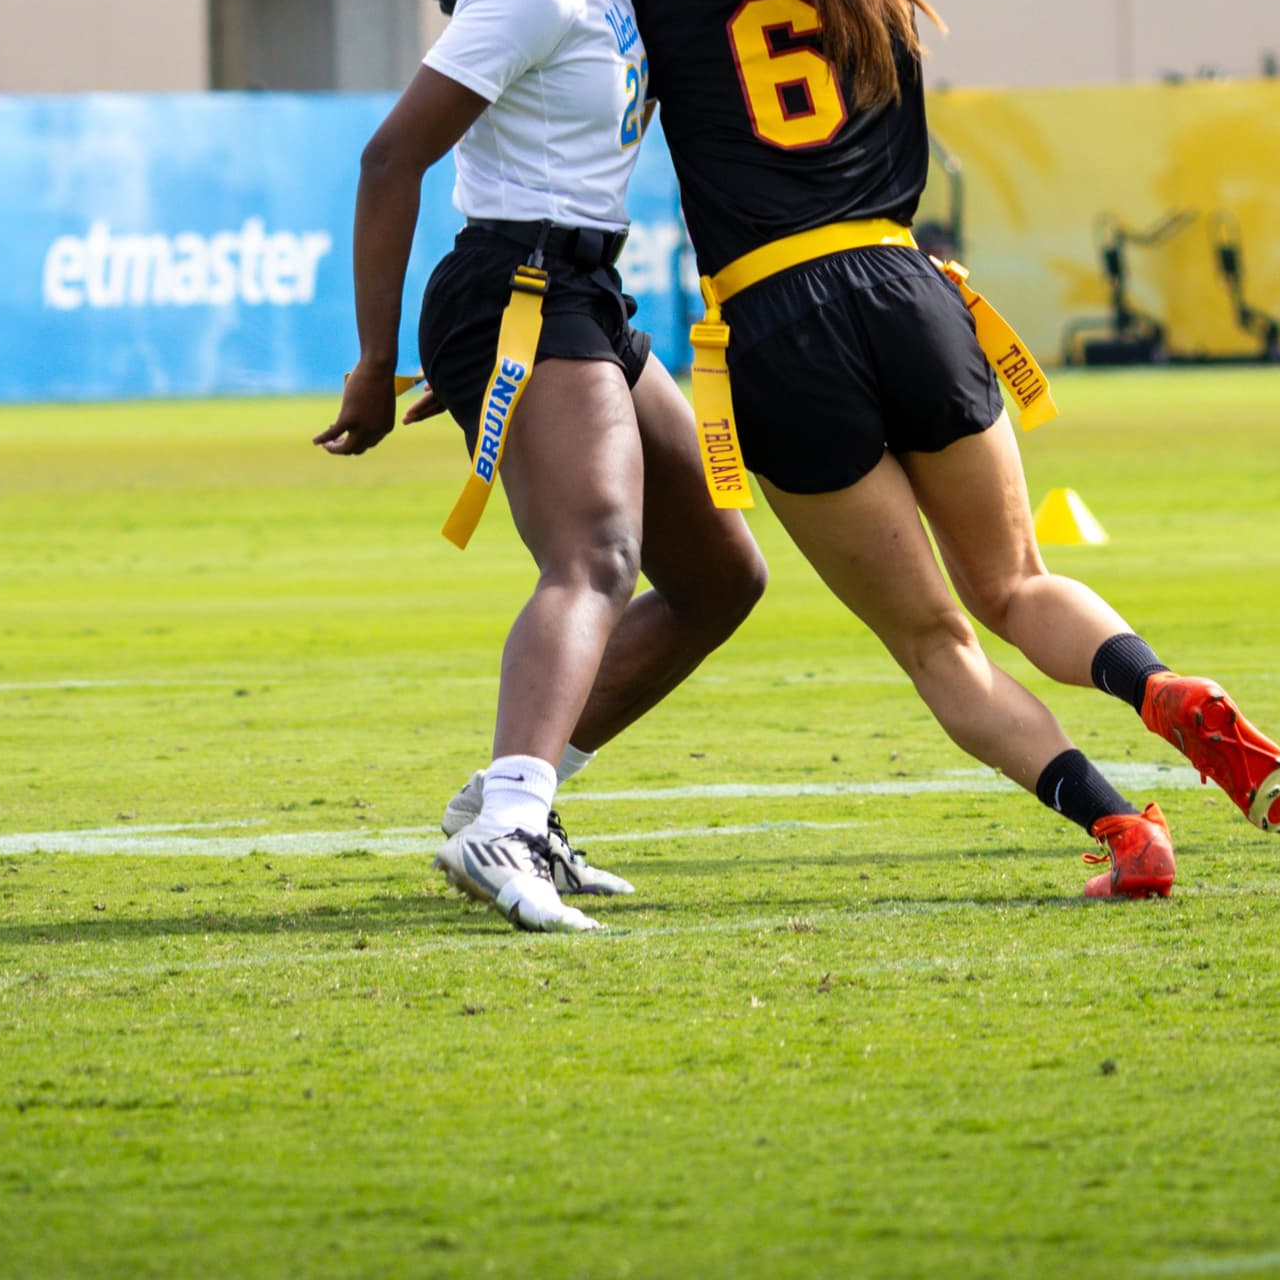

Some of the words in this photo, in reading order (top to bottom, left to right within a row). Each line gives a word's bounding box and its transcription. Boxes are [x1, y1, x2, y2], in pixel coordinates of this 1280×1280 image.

[620, 53, 649, 150] 2
[475, 357, 527, 484] BRUINS
[702, 417, 743, 493] TROJANS
